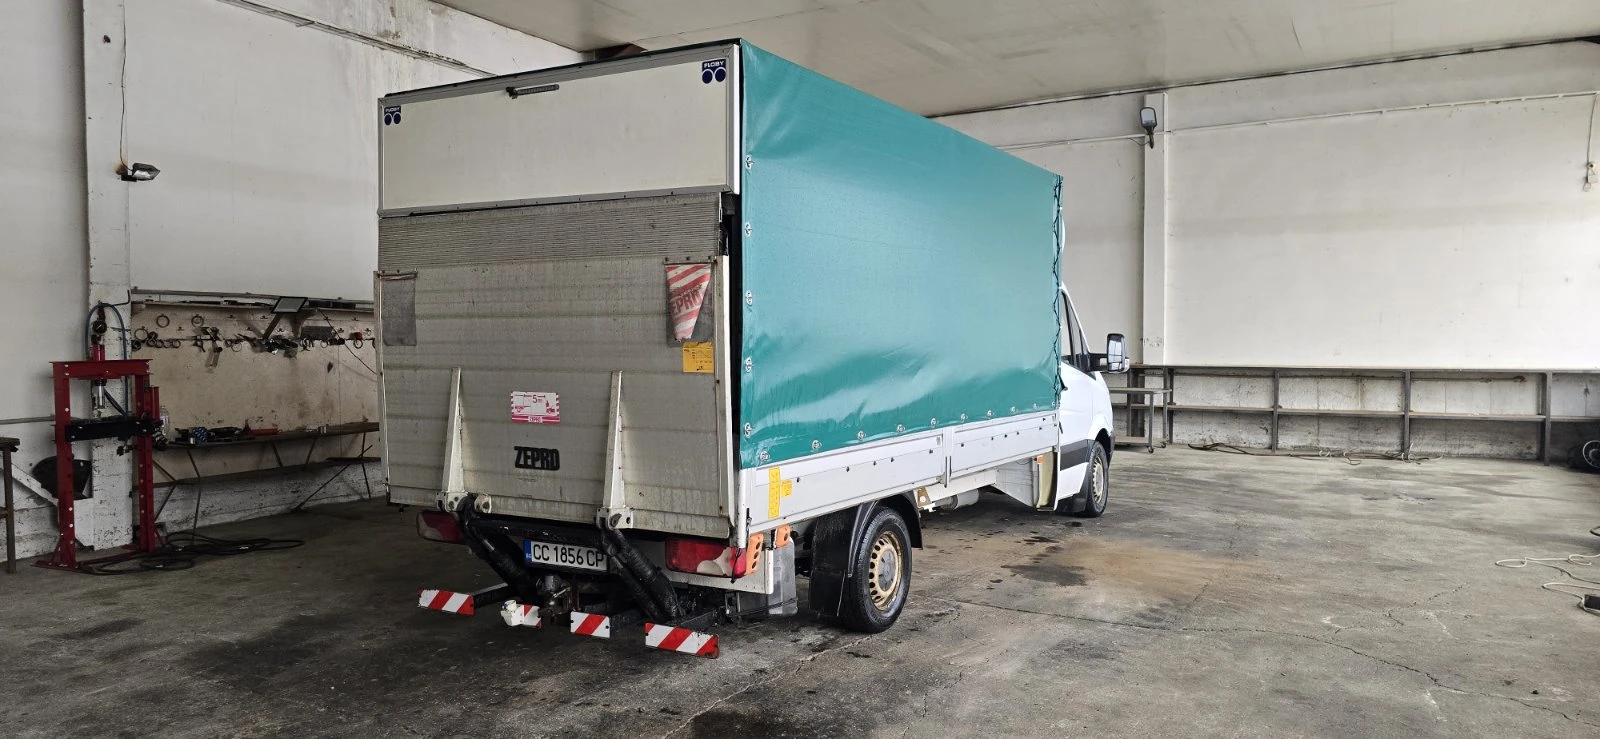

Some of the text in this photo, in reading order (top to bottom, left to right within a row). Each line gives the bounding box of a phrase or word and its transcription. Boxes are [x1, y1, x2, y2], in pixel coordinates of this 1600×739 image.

[703, 60, 725, 69] FLOBY
[514, 446, 560, 471] ZEPRO
[533, 544, 604, 567] CC 1856 CP
